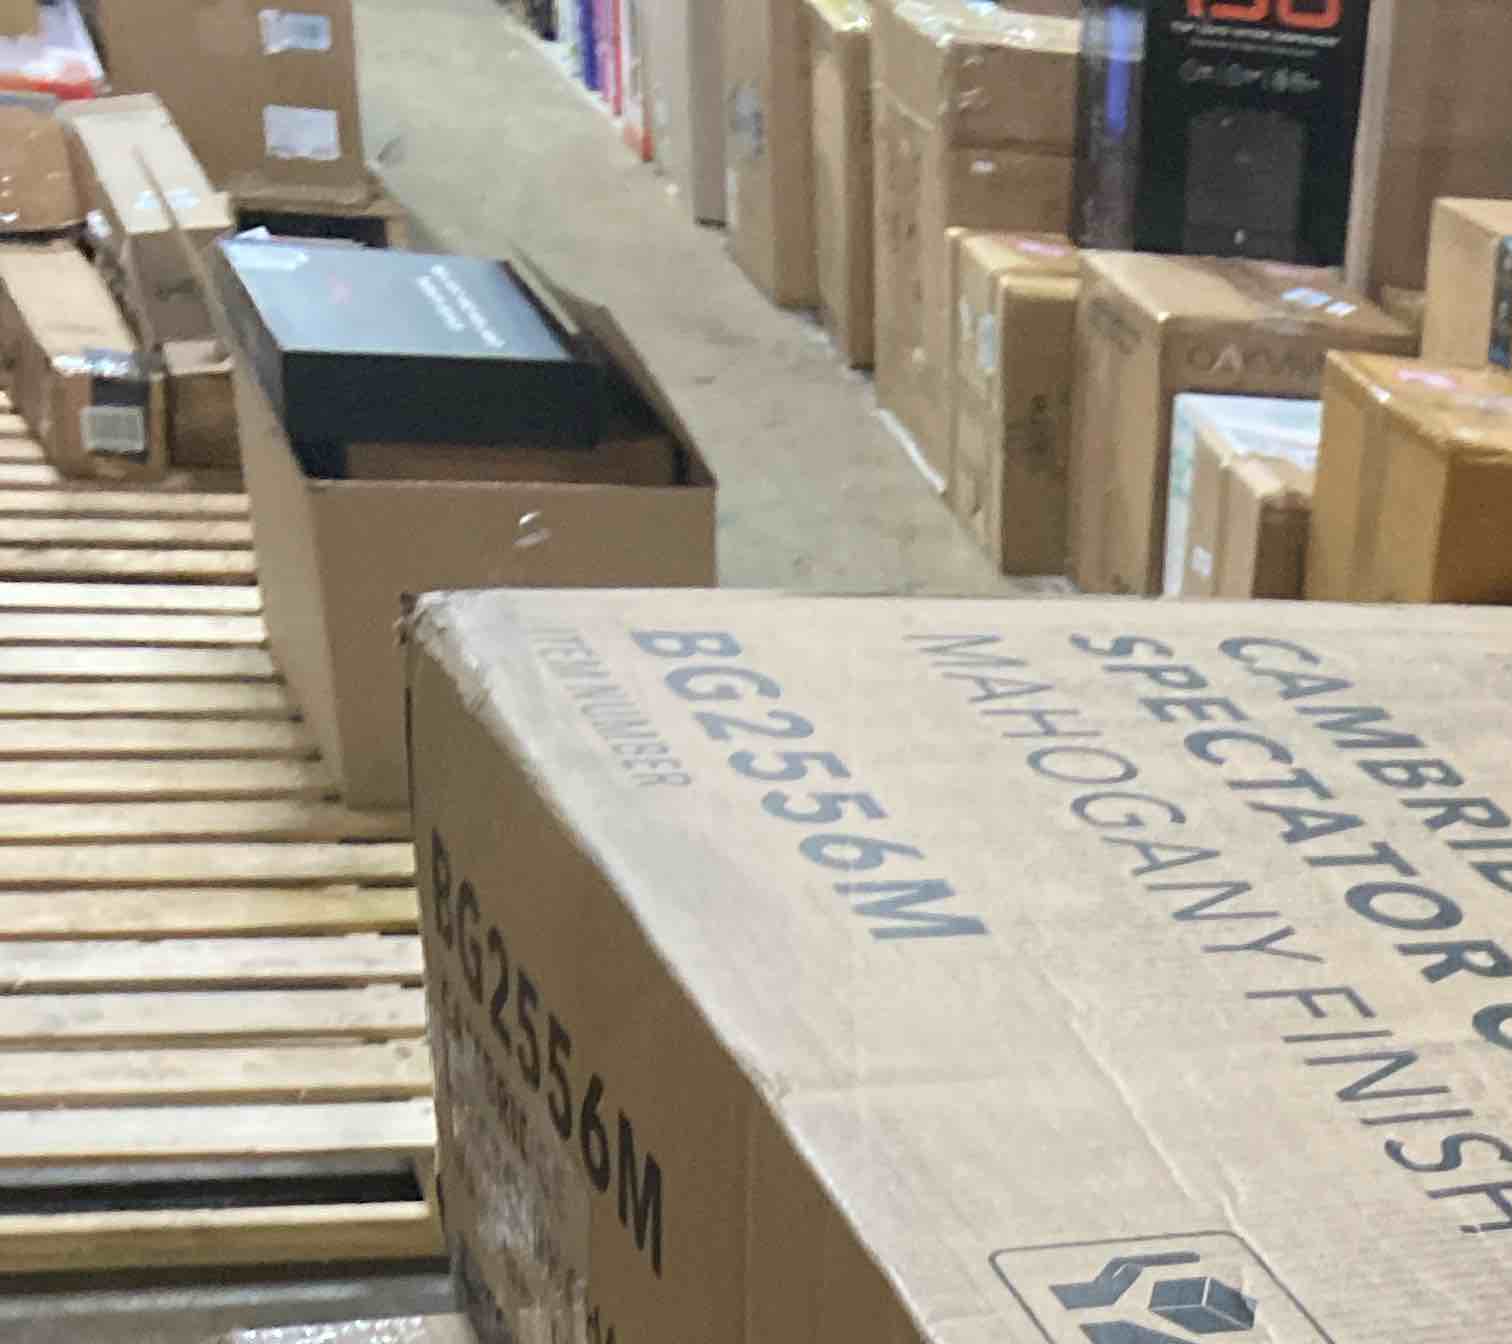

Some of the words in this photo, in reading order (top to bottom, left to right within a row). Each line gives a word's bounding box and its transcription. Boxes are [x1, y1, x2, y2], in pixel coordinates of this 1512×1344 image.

[630, 629, 992, 941] BG2556M
[902, 633, 1326, 964] MAHOGANY
[431, 826, 662, 1281] BG2556M
